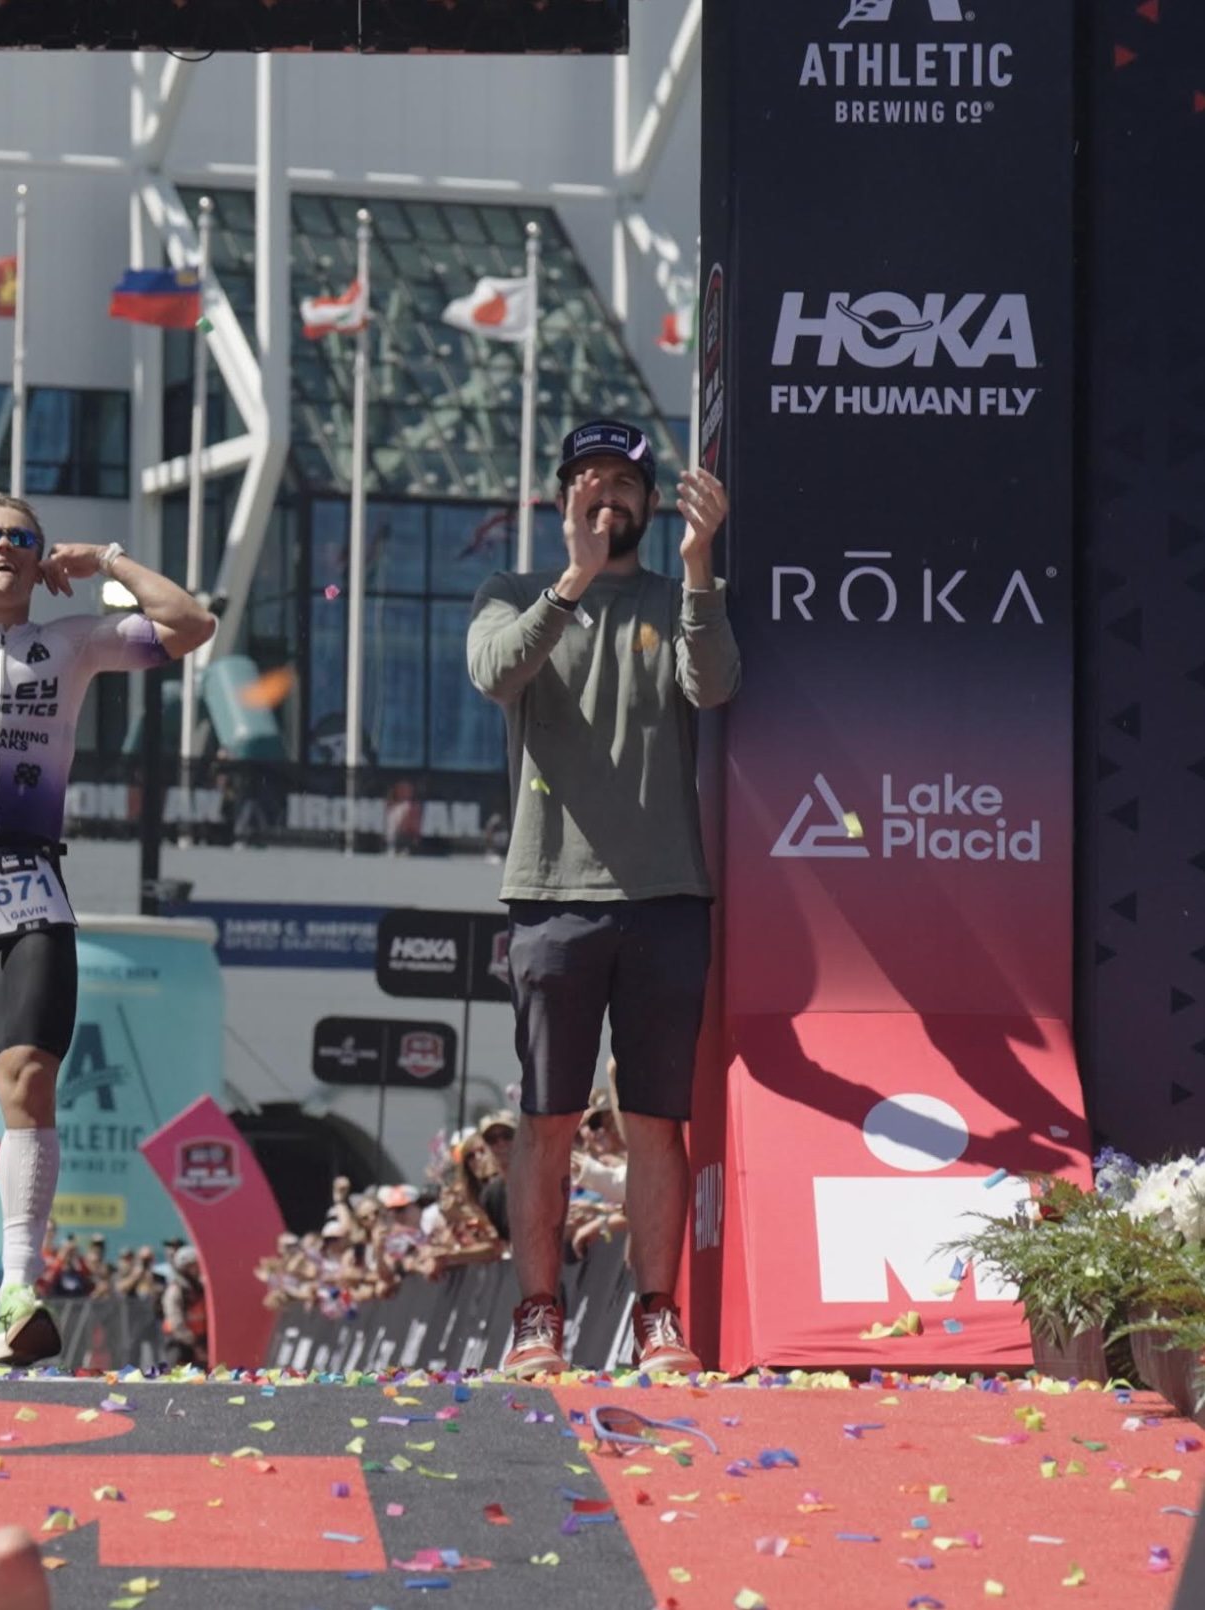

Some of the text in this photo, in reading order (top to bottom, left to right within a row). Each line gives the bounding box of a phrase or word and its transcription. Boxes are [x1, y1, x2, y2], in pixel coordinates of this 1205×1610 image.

[799, 42, 1013, 88] ATHLETIC
[835, 100, 945, 123] BREWING
[771, 291, 1038, 369] HOKA
[771, 385, 1037, 417] FLY HUMAN FLY
[883, 773, 1003, 816] Lake
[883, 818, 1041, 862] Placid
[11, 905, 48, 920] GAVIN
[390, 936, 457, 961] HOKA
